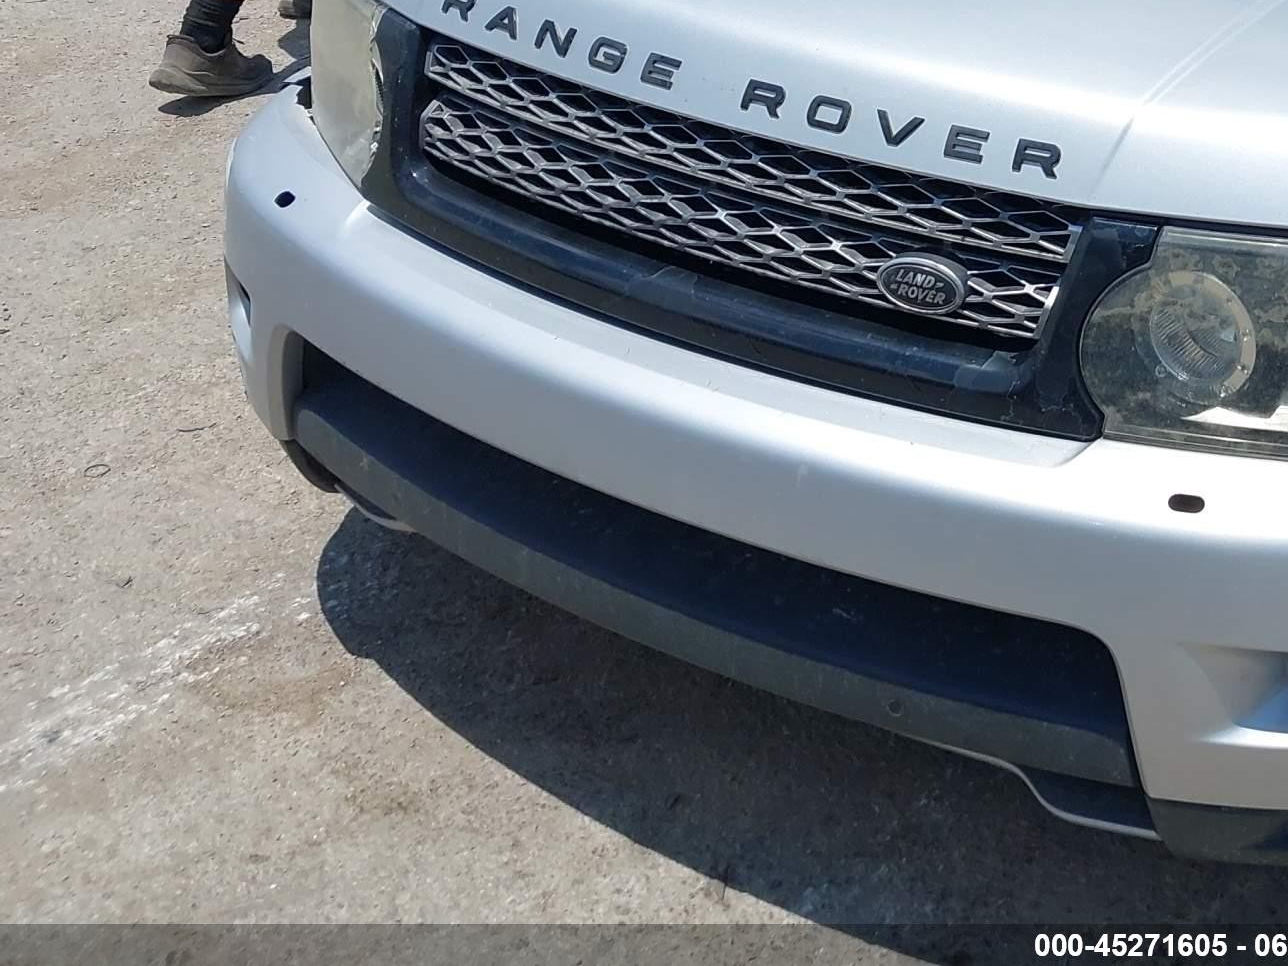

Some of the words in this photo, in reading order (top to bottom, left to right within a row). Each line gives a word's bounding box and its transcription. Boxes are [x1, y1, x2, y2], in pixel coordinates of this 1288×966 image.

[739, 77, 1063, 180] ROVER
[896, 268, 936, 289] LAND
[896, 283, 947, 306] ROVER
